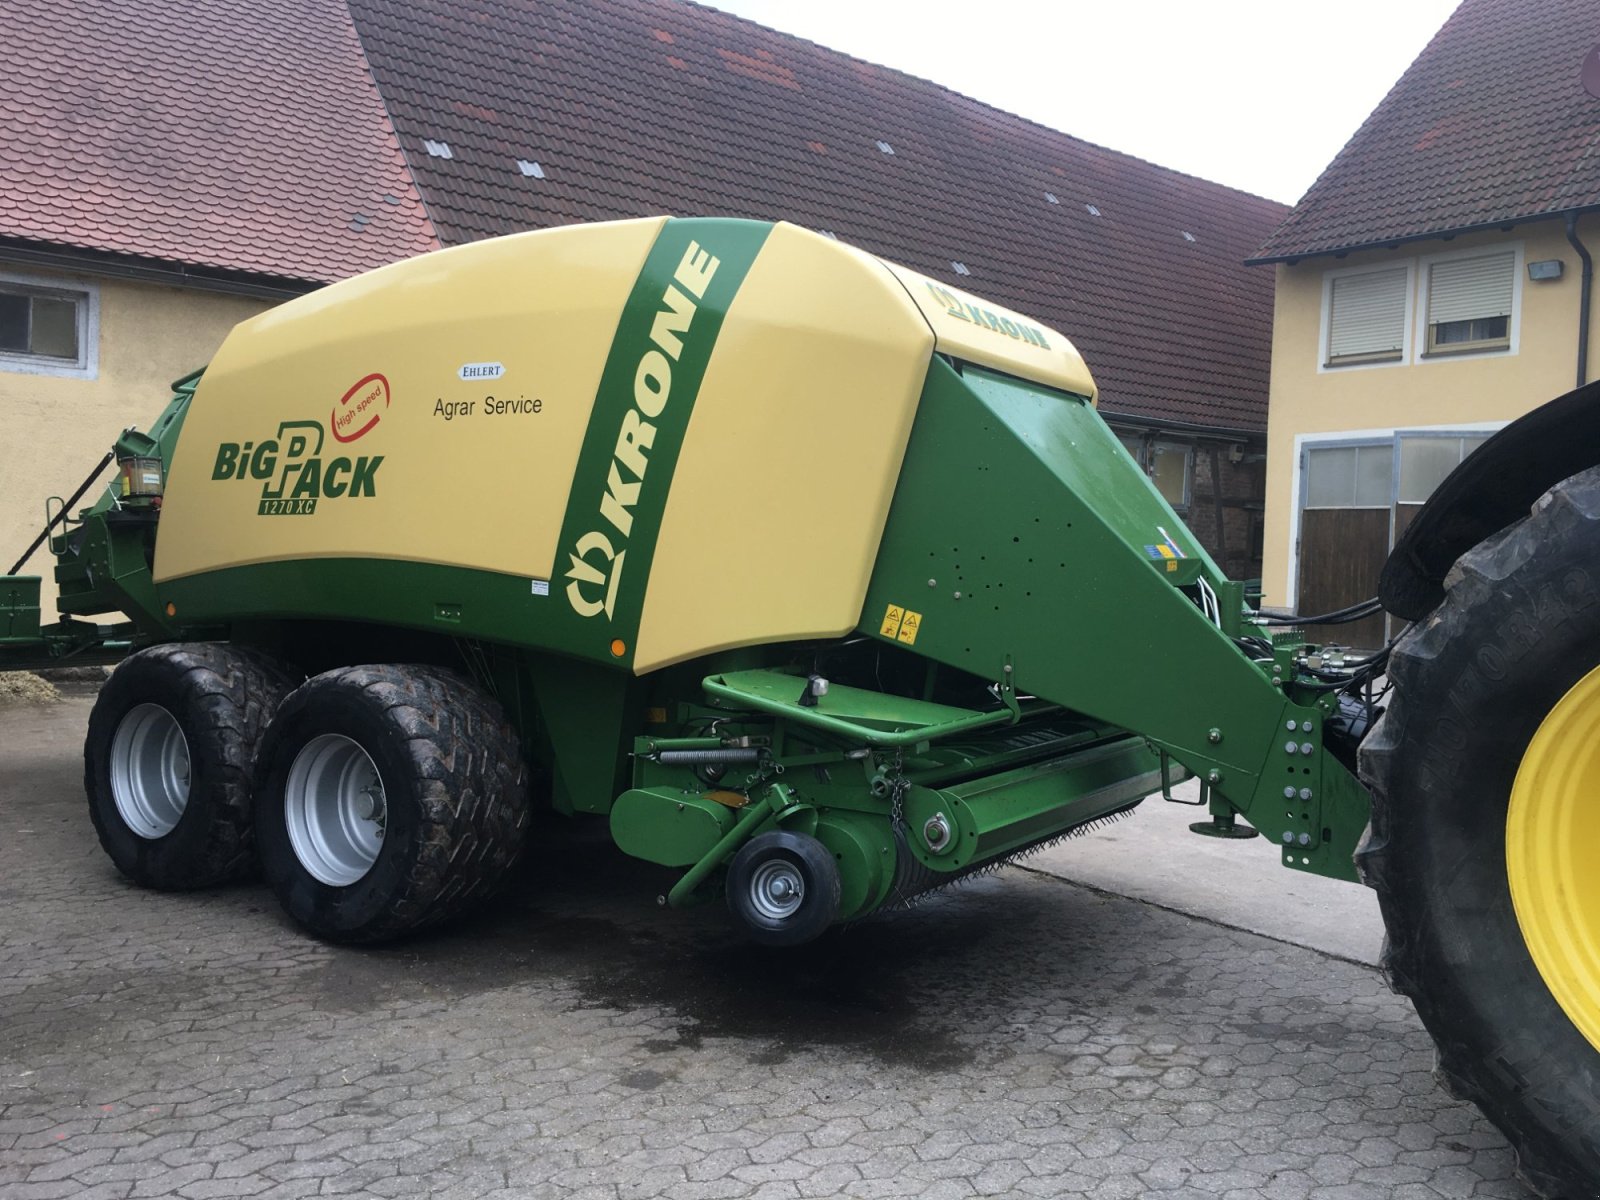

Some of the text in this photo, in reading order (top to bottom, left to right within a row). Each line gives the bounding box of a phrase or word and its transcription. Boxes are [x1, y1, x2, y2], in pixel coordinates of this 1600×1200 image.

[966, 303, 1052, 351] KRONE
[462, 365, 501, 377] EHLERT
[599, 240, 720, 538] KRONE
[336, 385, 382, 430] High speed
[433, 395, 543, 421] Agrar Service
[261, 420, 385, 499] PACK
[264, 499, 314, 515] 1270 XC
